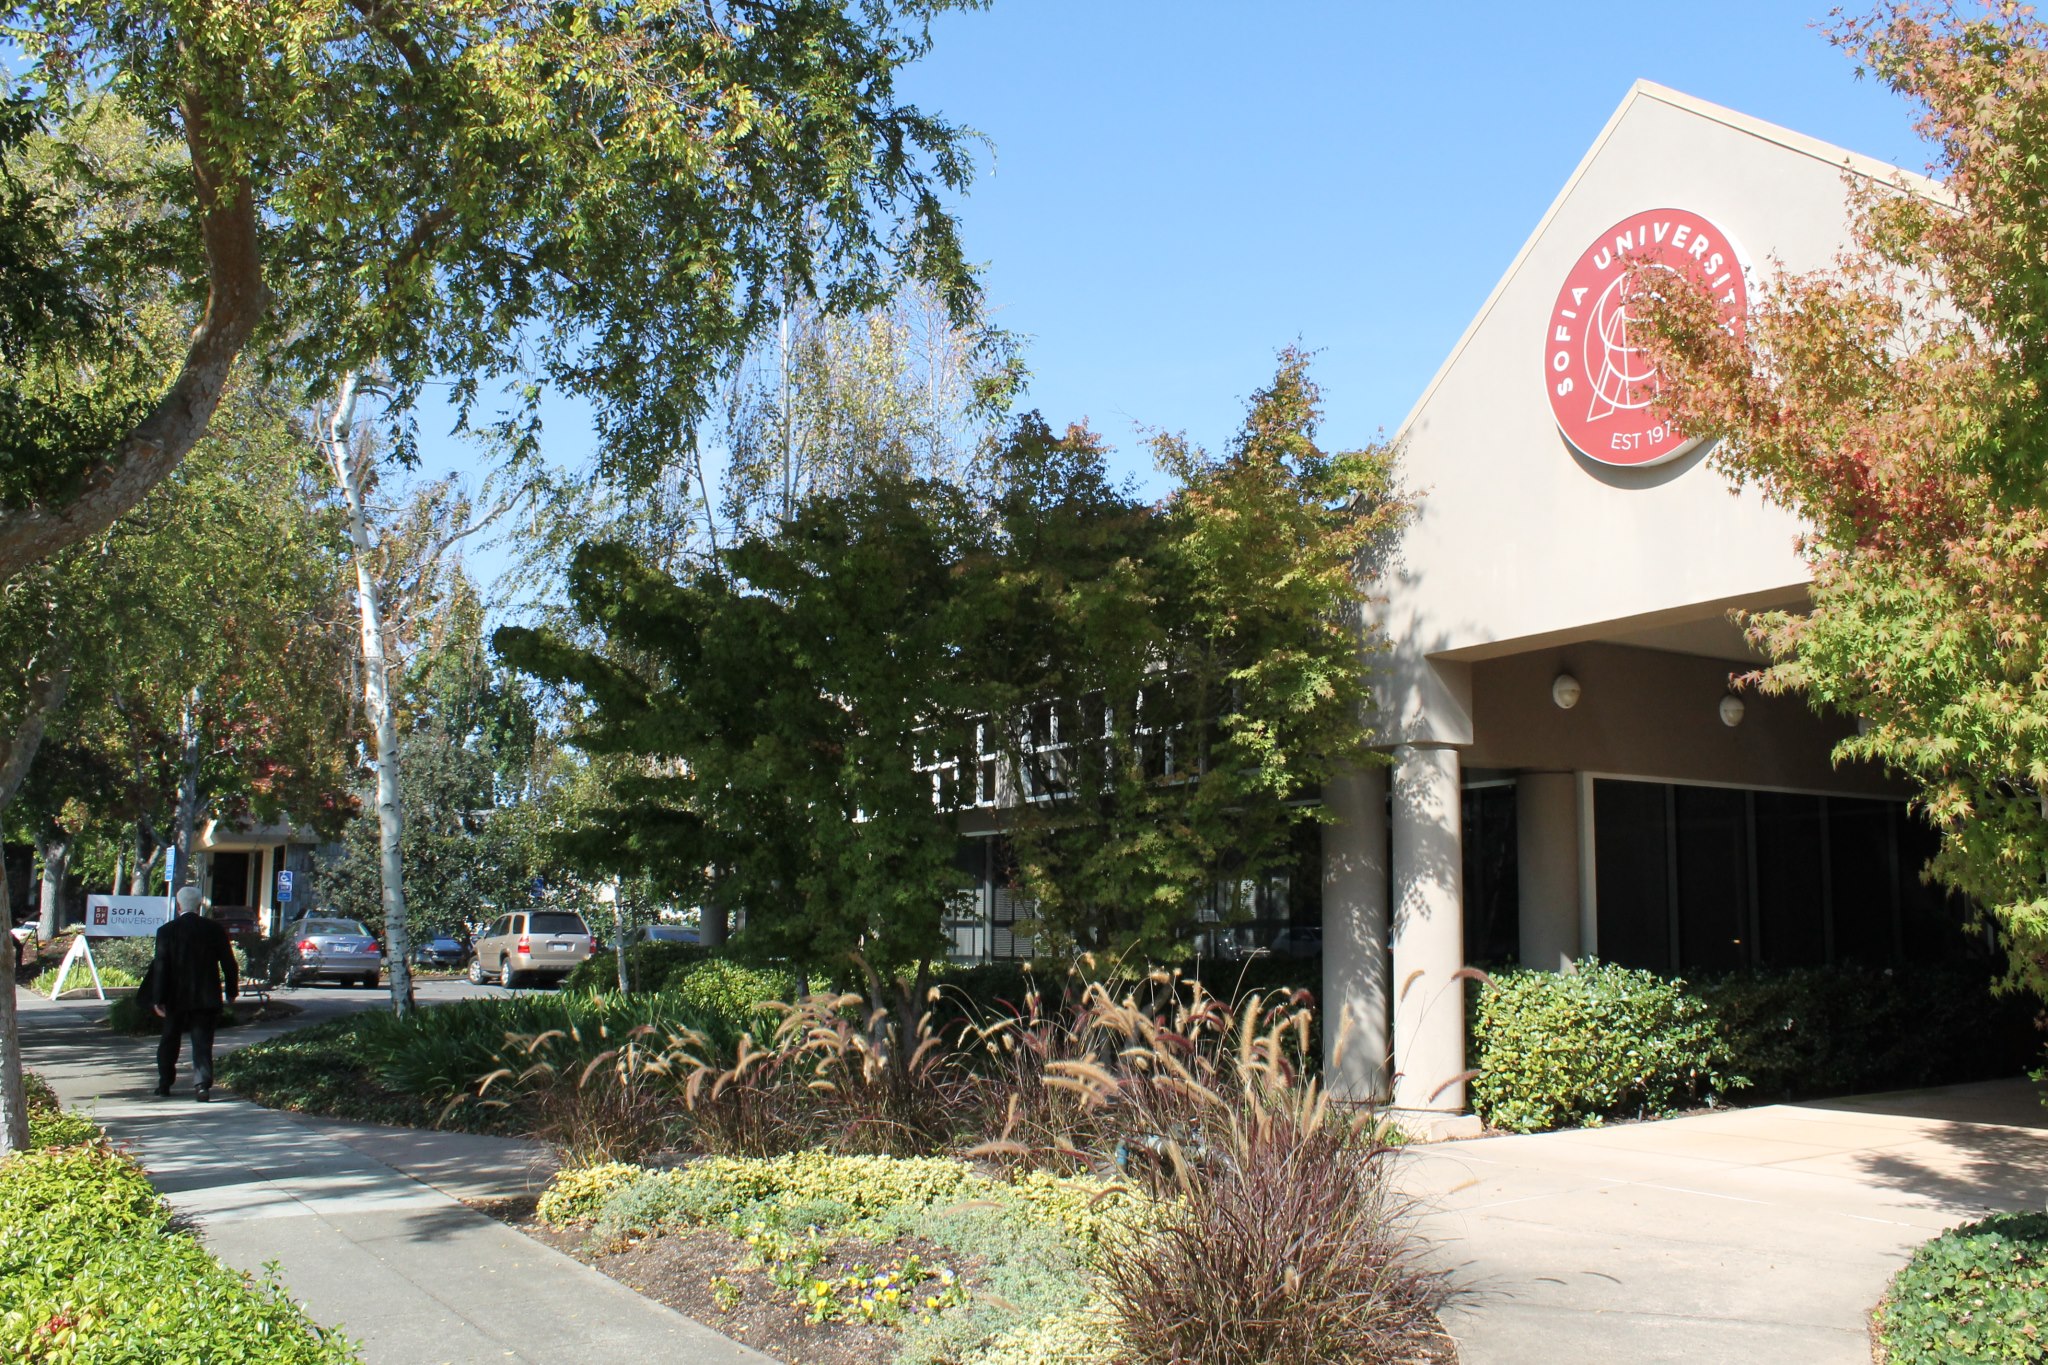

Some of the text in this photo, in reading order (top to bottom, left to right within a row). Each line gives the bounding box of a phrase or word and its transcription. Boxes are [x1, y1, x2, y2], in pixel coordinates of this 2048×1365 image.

[1553, 221, 1737, 397] SOFIA UNIVERSITY
[1610, 413, 1680, 450] EST 197
[111, 908, 145, 916] SOFIA
[111, 917, 166, 925] UNIVERSITY
